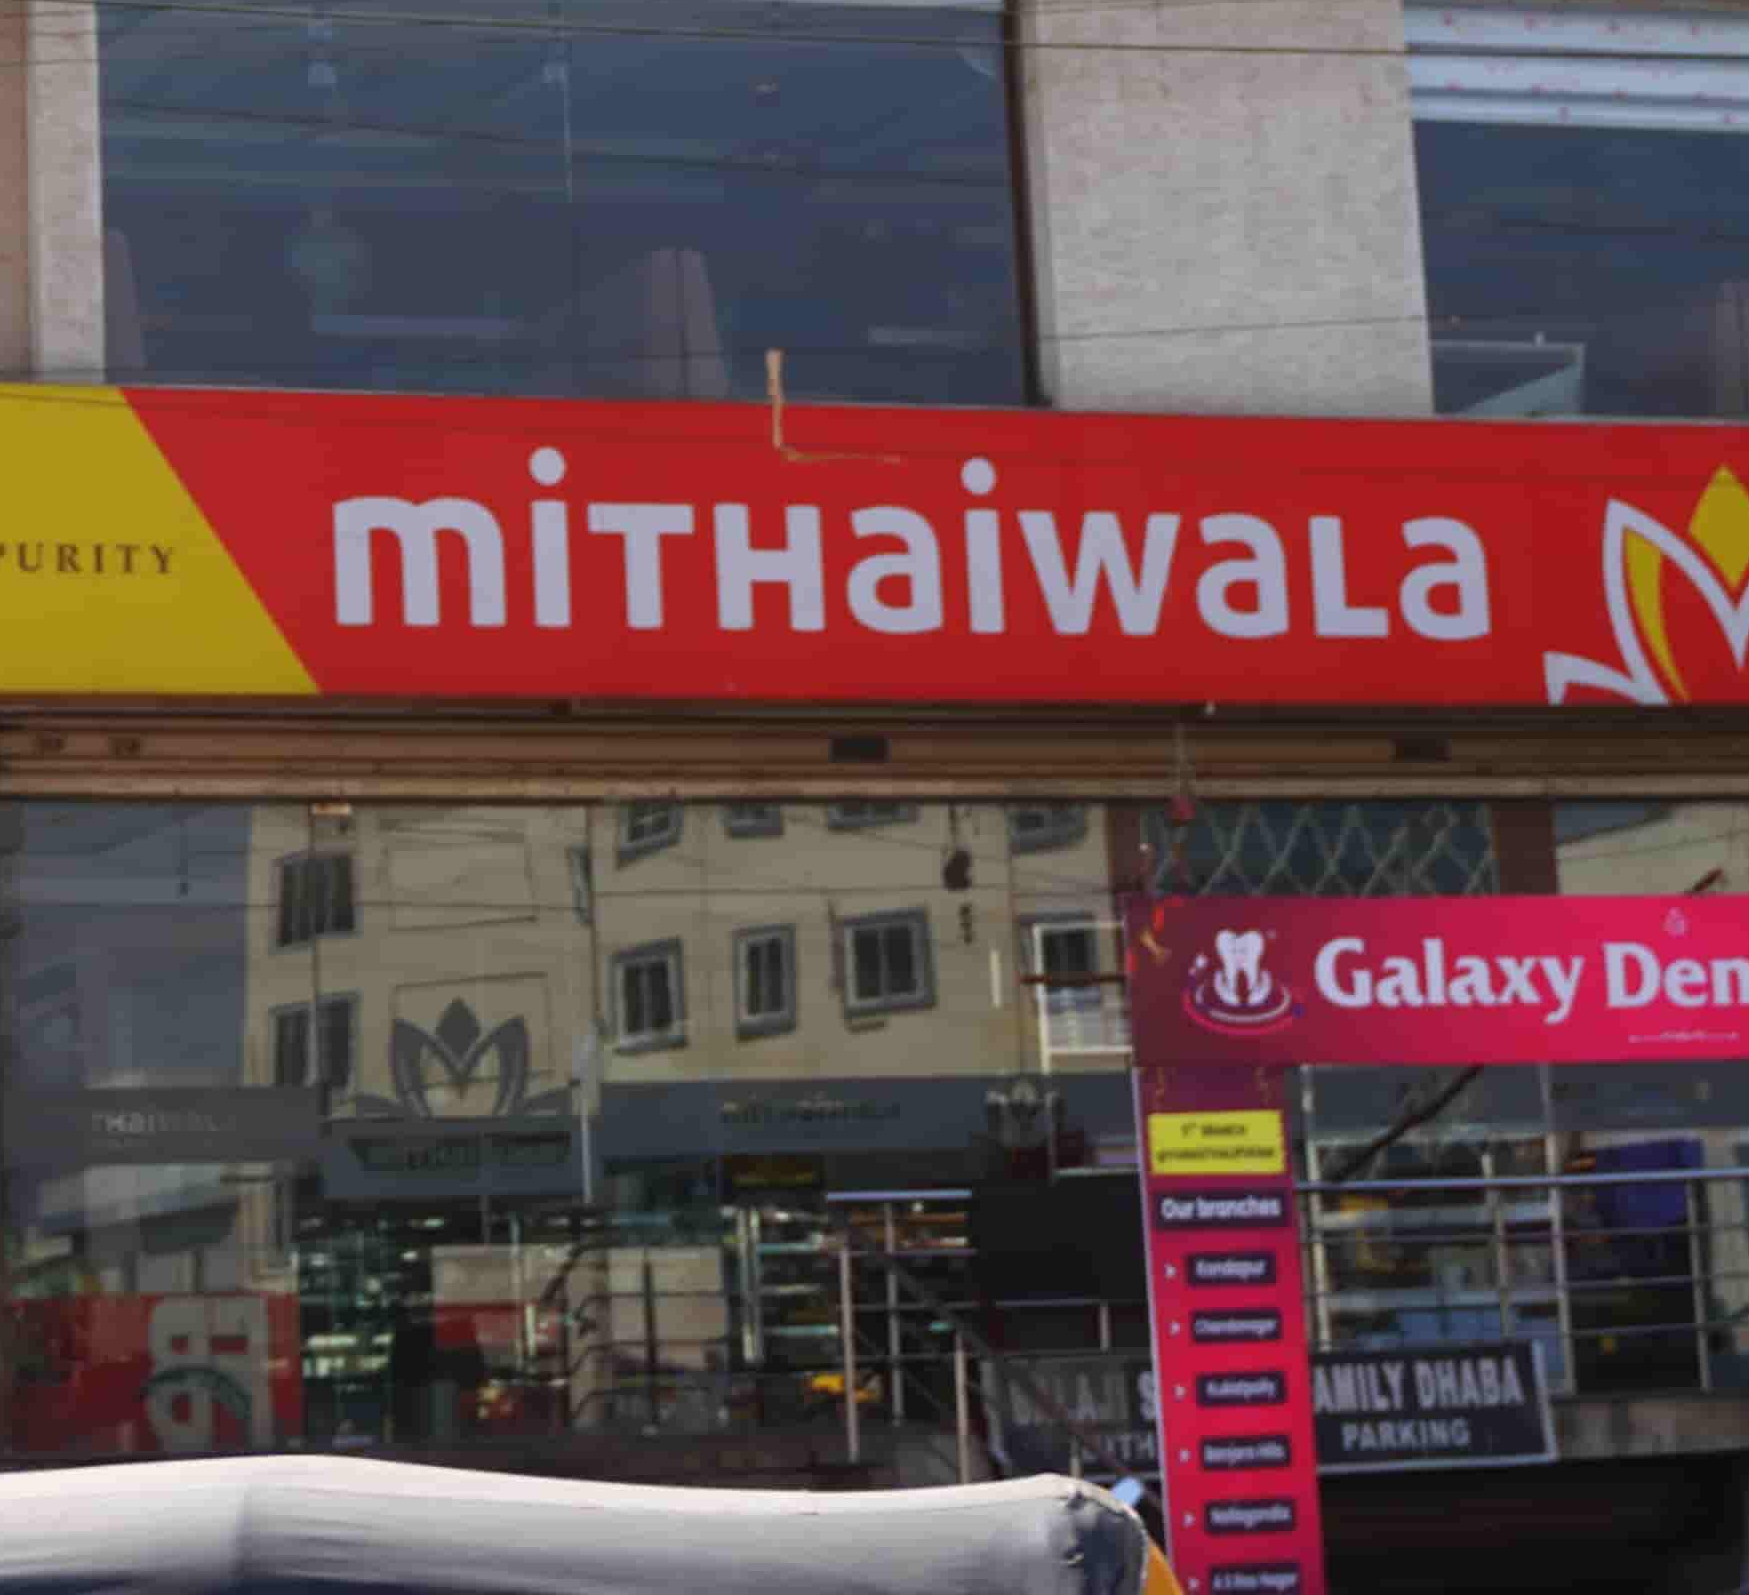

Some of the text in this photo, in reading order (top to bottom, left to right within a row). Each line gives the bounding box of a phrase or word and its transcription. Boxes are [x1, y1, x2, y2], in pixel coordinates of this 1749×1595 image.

[1314, 936, 1585, 1025] Galaxy
[1160, 1196, 1194, 1221] Our
[1313, 1361, 1405, 1414] AMILY
[1414, 1355, 1524, 1408] DHABA
[1340, 1416, 1471, 1454] PARKING
